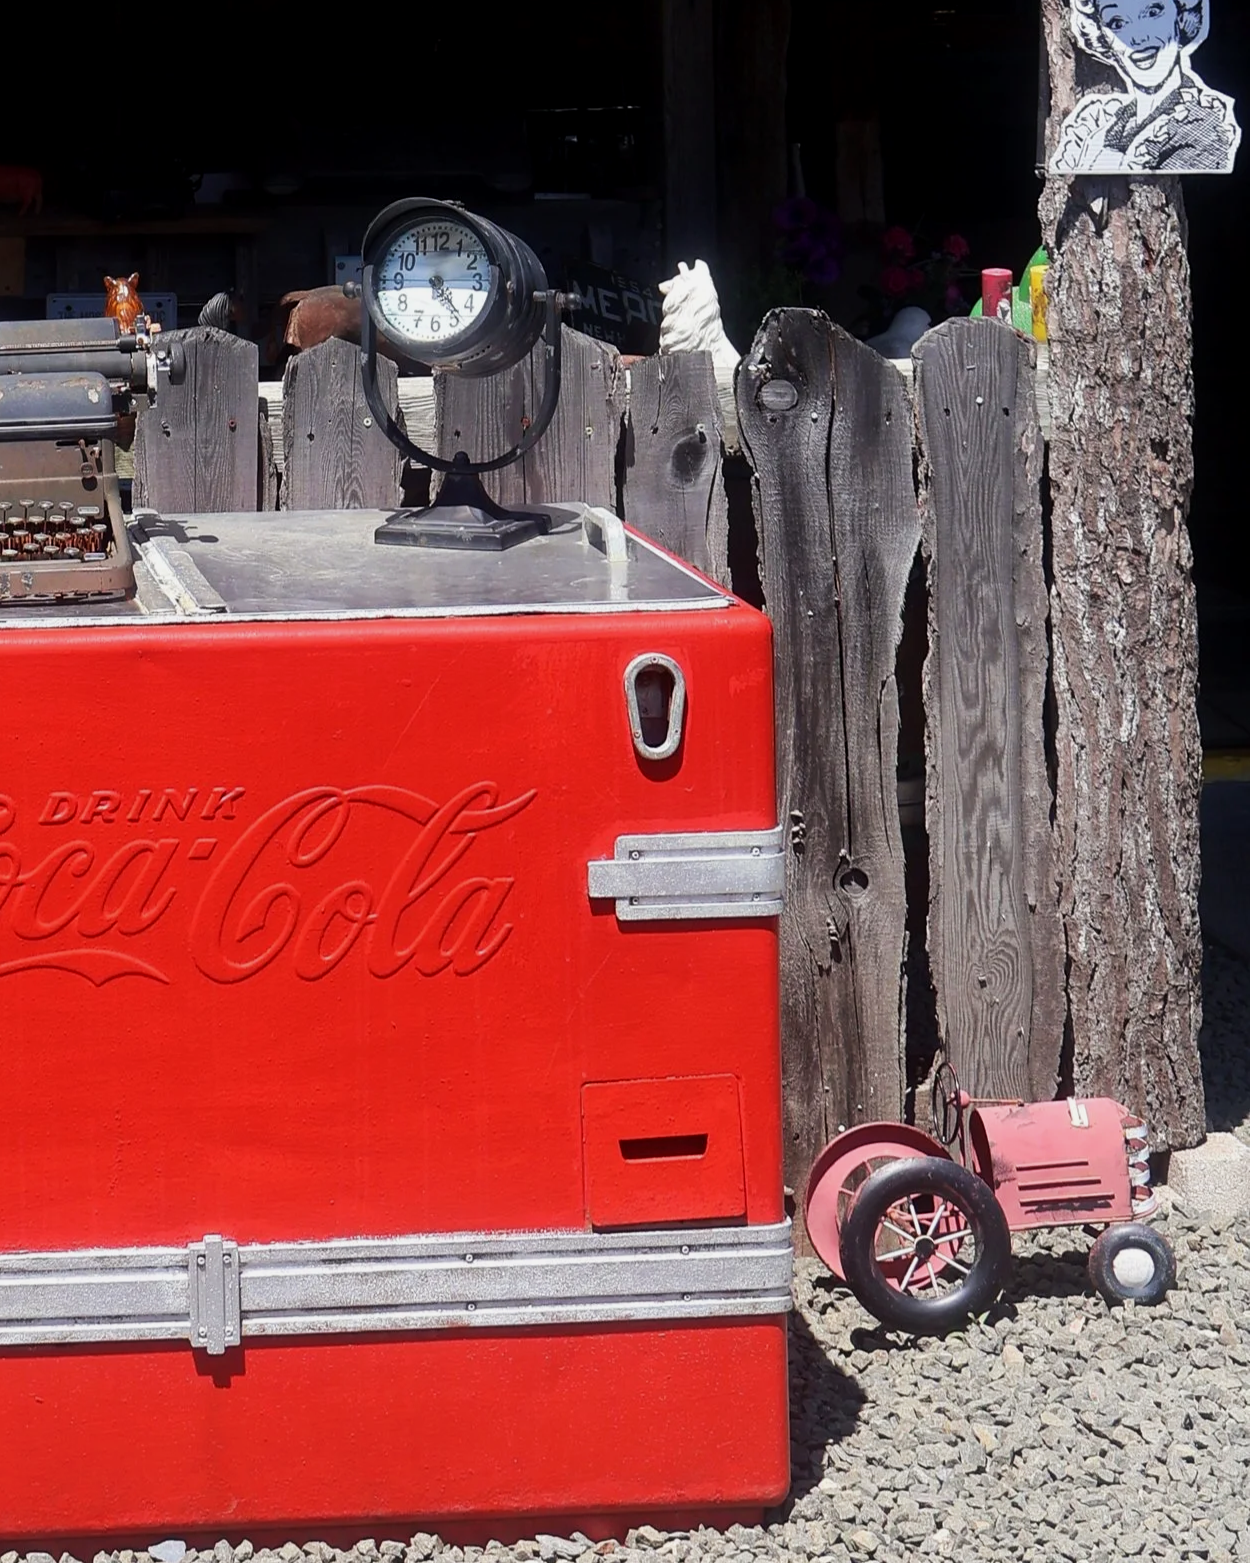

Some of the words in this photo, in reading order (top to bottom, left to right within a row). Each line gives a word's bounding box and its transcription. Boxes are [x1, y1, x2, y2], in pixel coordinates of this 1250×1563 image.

[414, 237, 428, 256] 11
[432, 231, 450, 247] 12
[399, 252, 416, 271] 10
[466, 253, 478, 271] 2
[393, 272, 404, 290] 9
[472, 272, 483, 291] 3
[397, 293, 408, 312] 8
[464, 294, 475, 313] 4
[413, 310, 424, 328] 7
[430, 315, 441, 333] 6
[39, 787, 247, 826] DRINK
